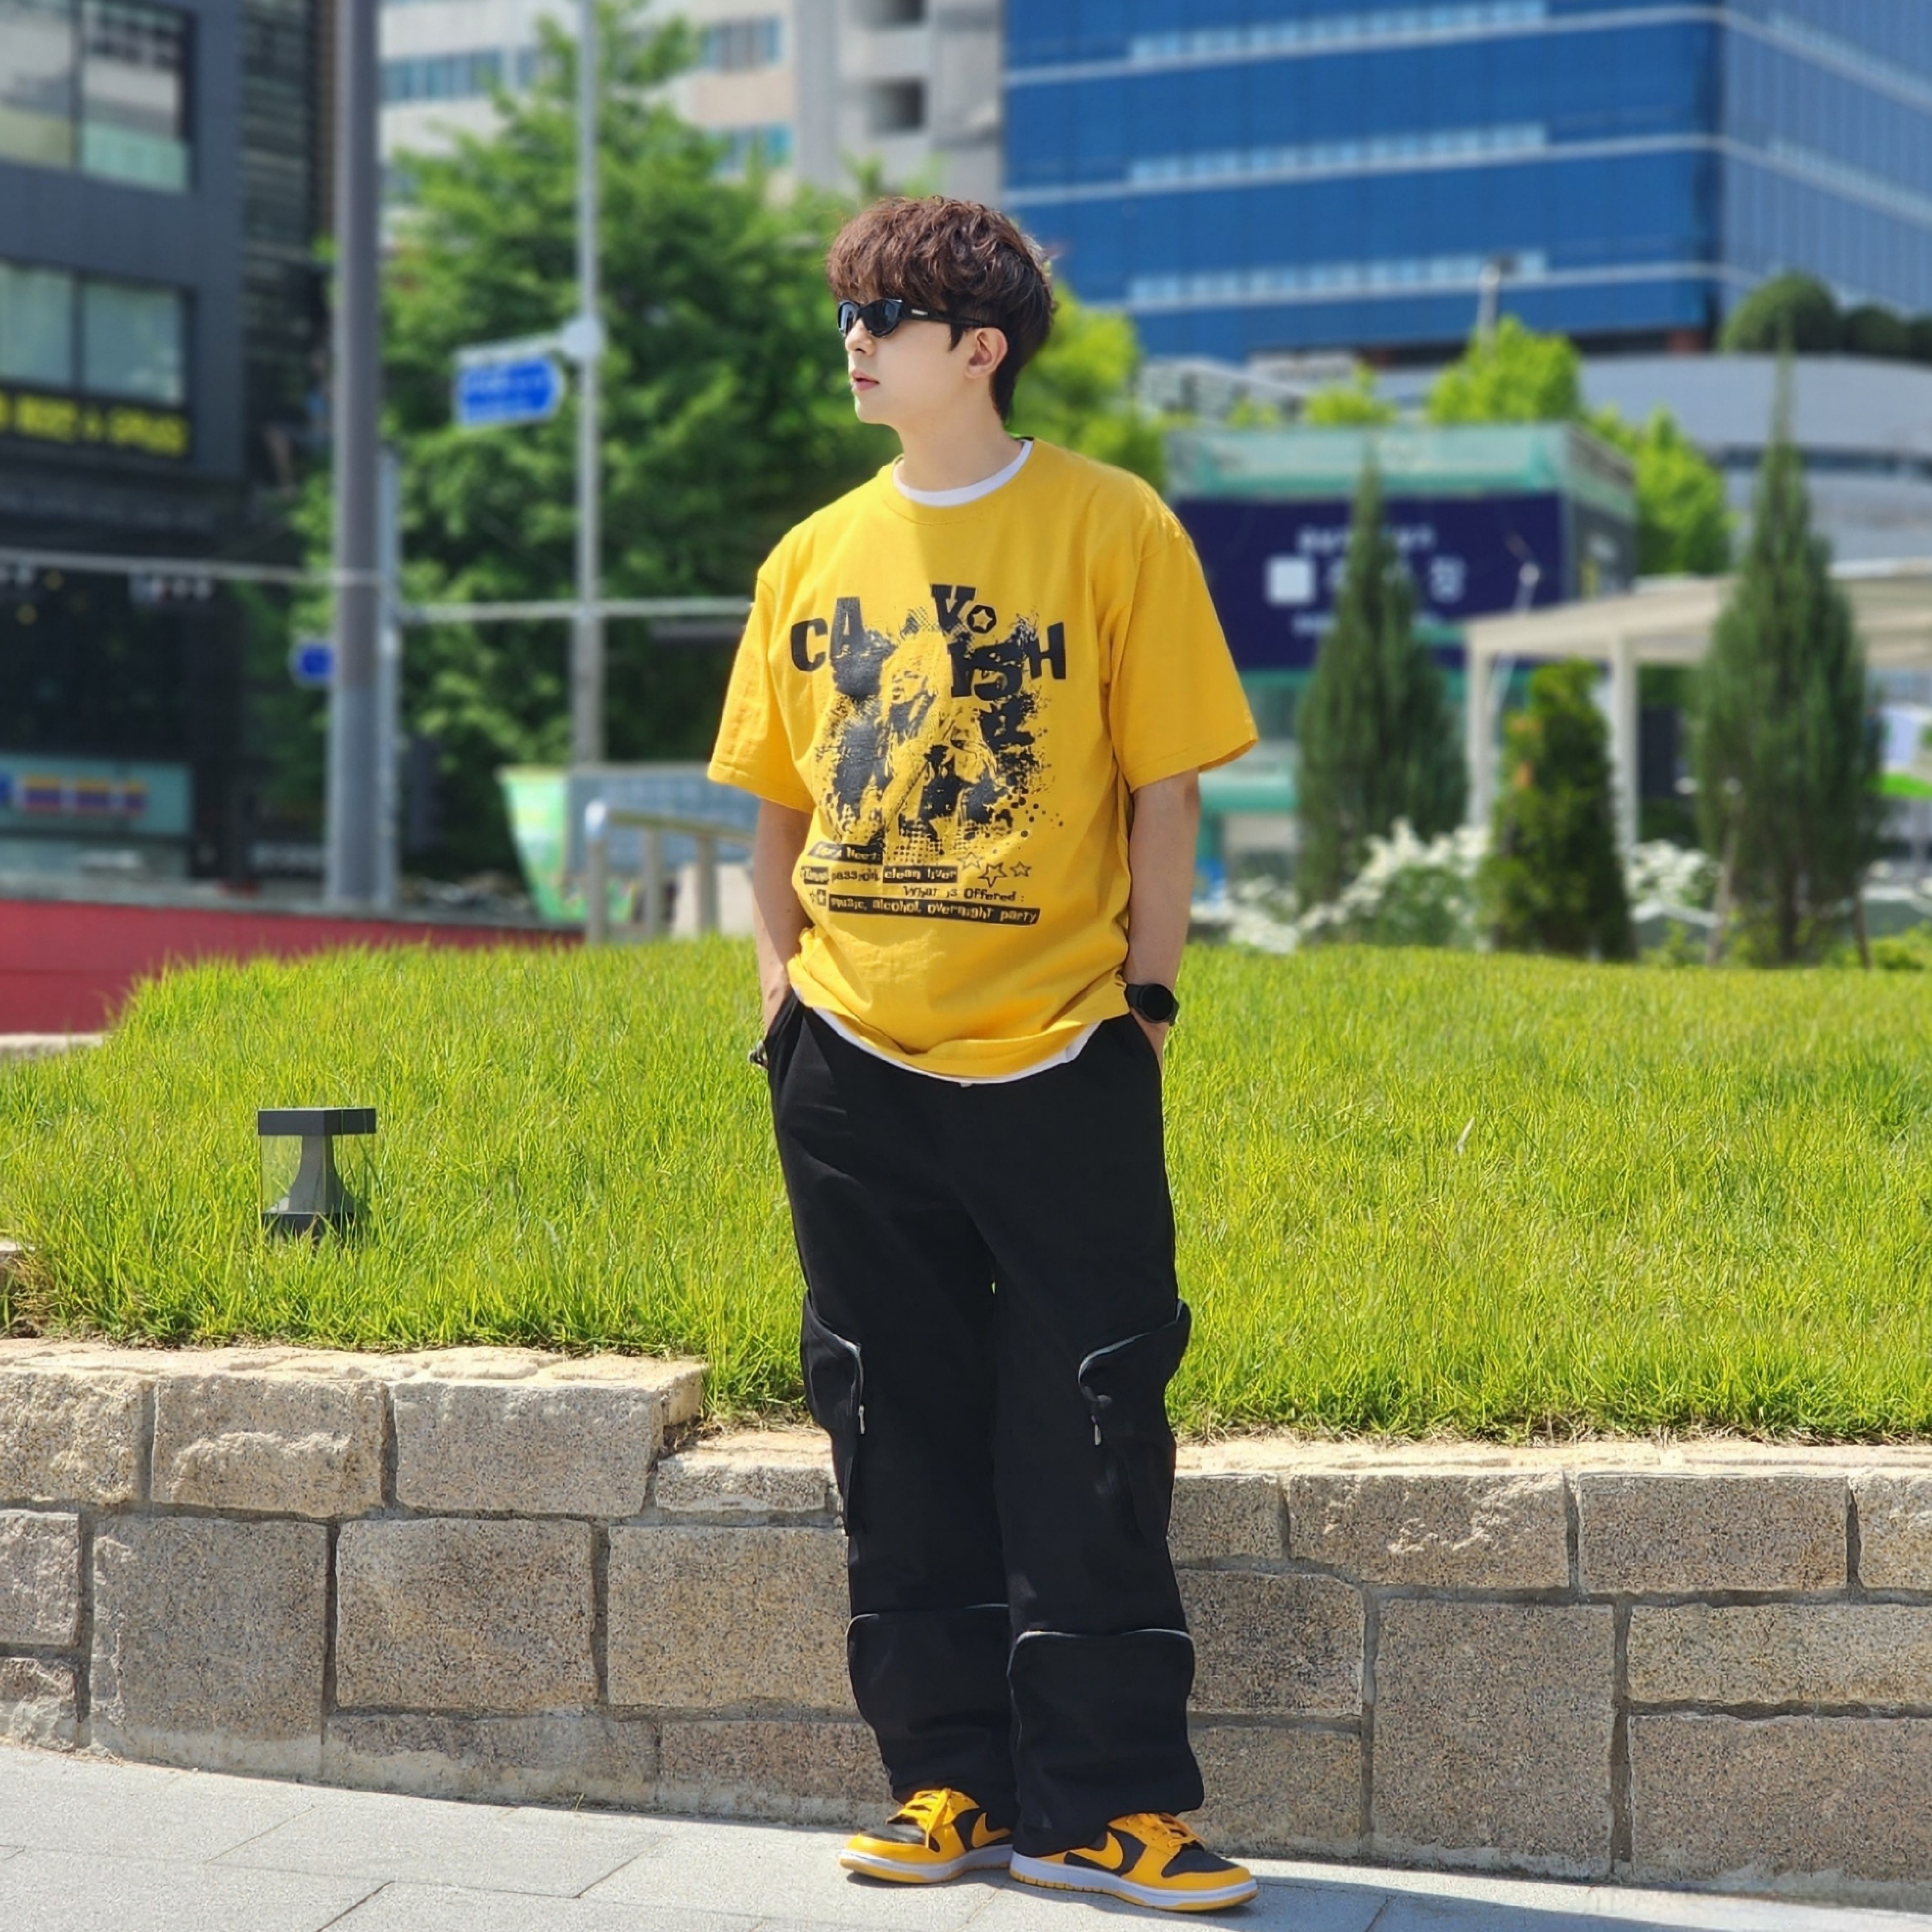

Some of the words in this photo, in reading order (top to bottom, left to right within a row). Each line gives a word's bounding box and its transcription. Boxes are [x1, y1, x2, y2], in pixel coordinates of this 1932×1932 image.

[884, 868, 922, 879] clean
[903, 885, 940, 899] What
[945, 888, 958, 899] is
[927, 903, 995, 921] overnight
[1000, 909, 1037, 925] party
